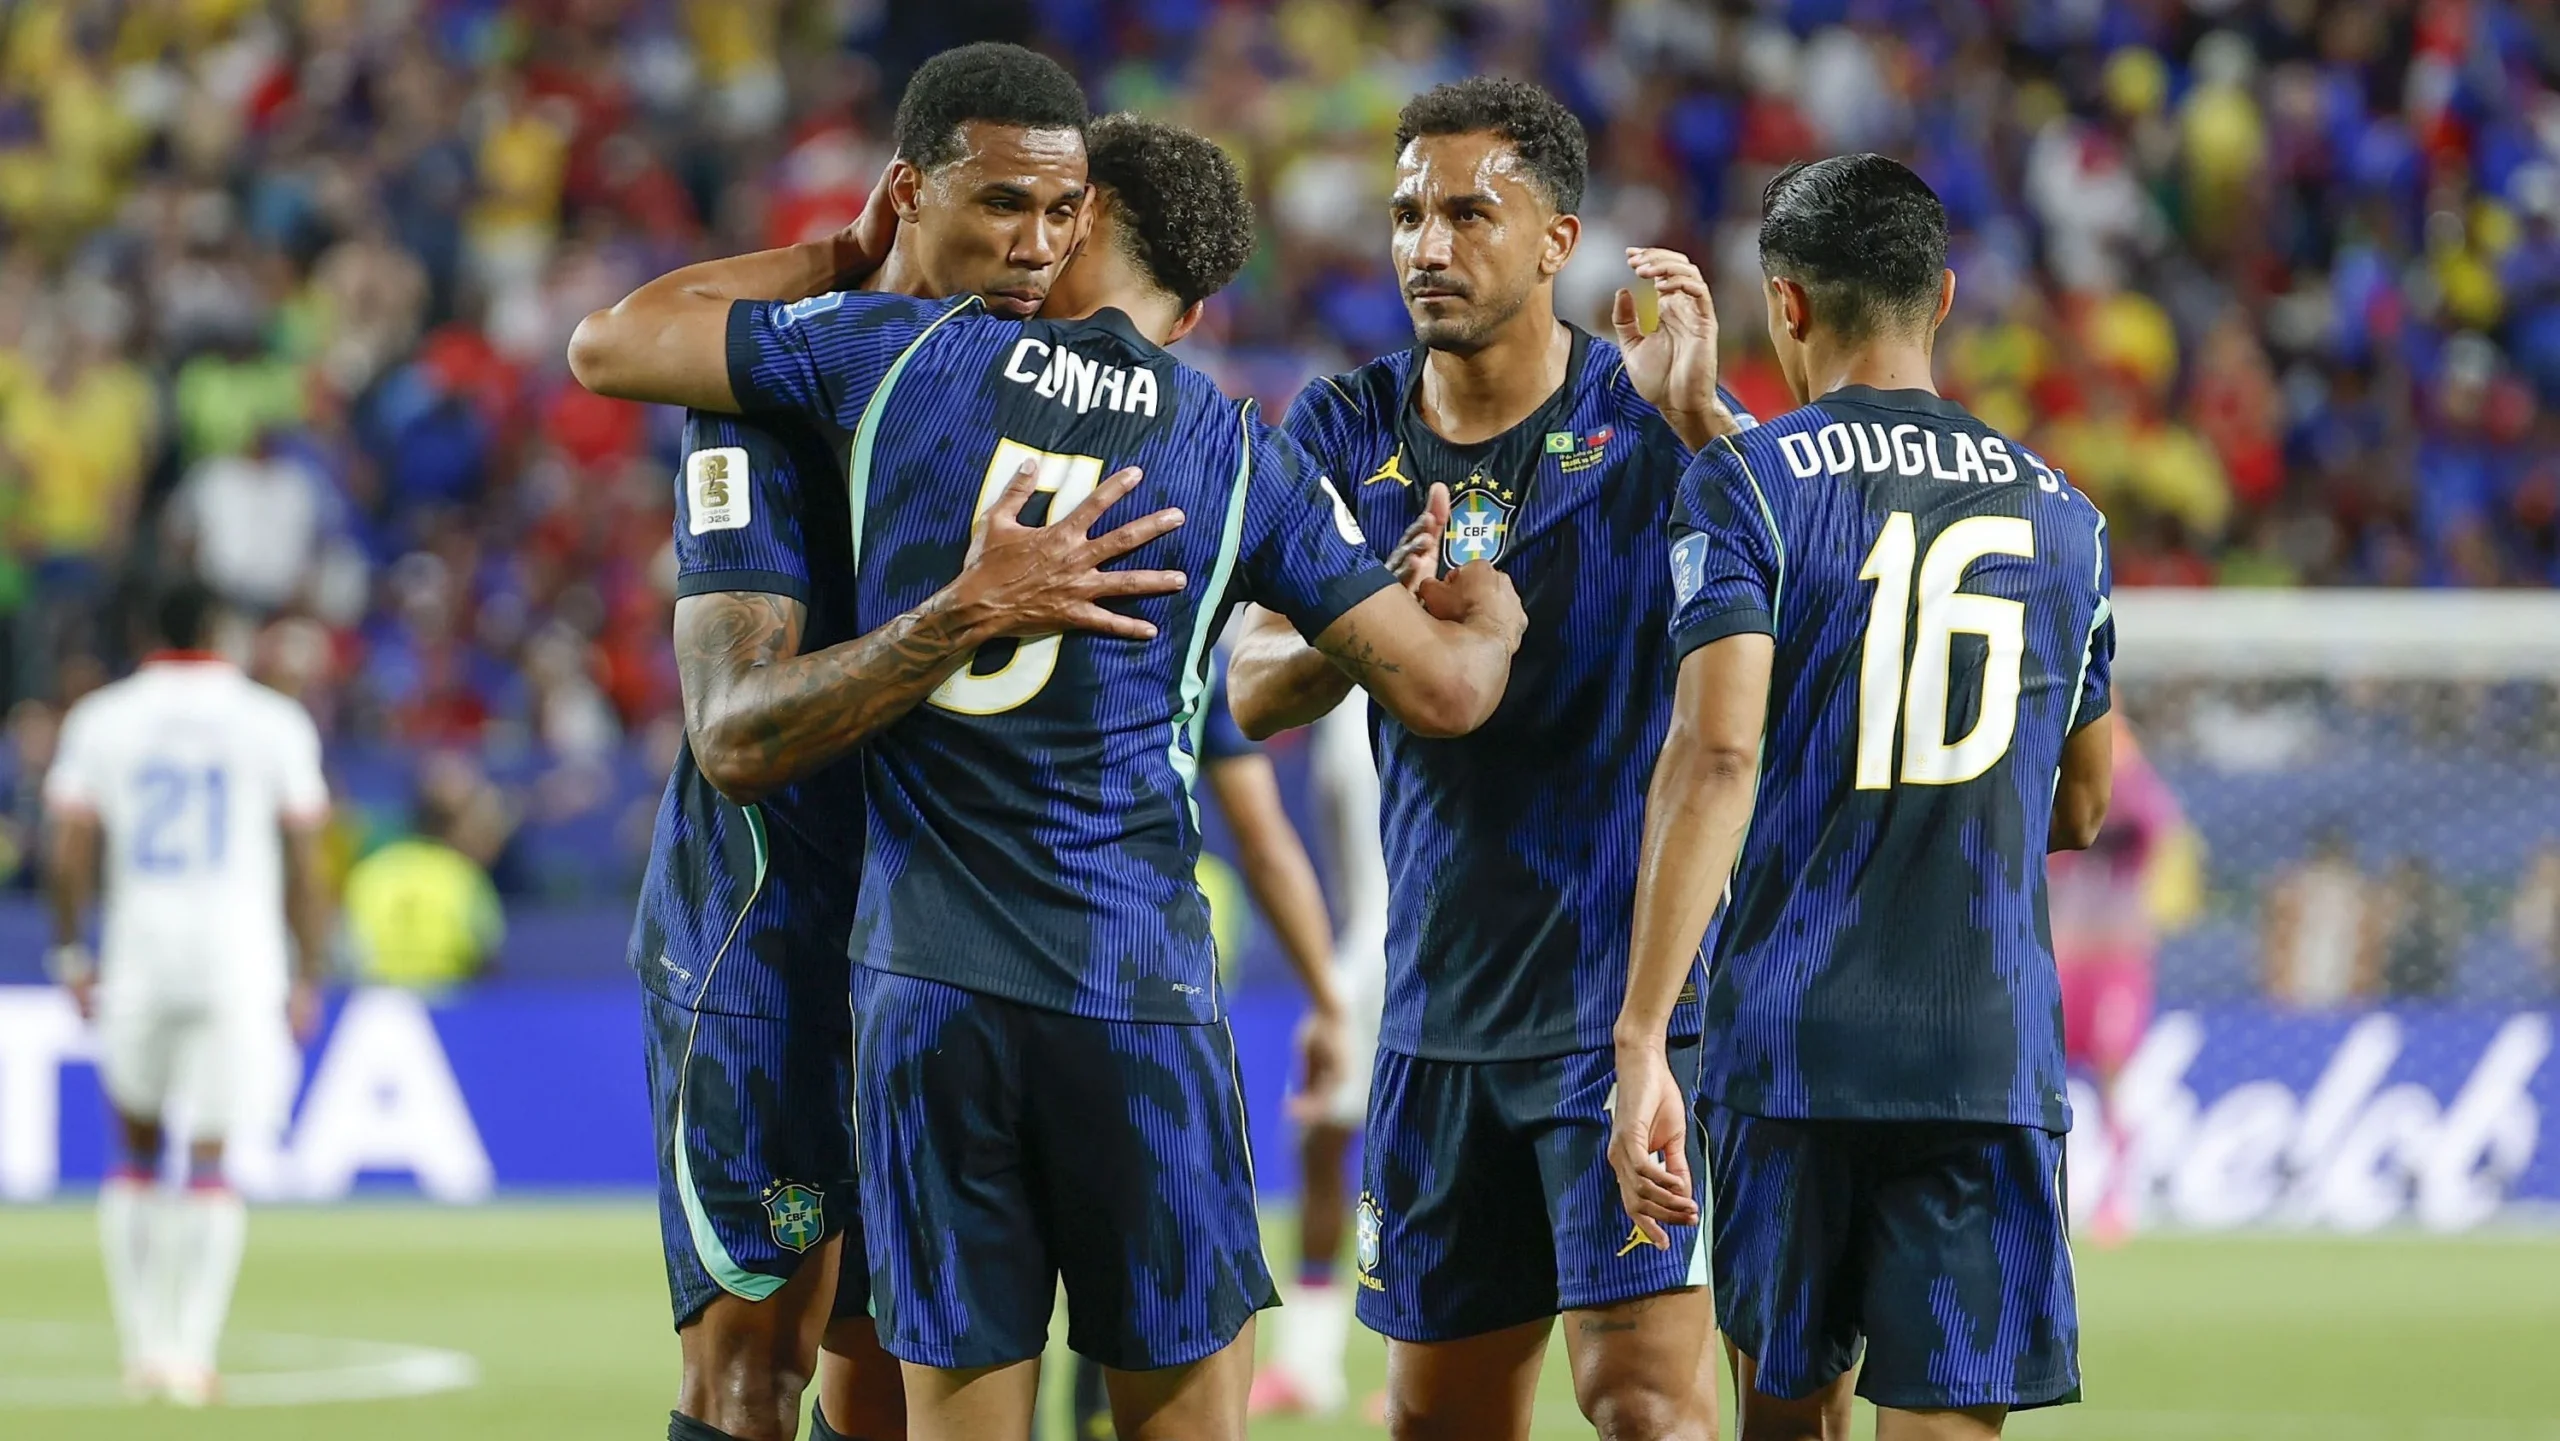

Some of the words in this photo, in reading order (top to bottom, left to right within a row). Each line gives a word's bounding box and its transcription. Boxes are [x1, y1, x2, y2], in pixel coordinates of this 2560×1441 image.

[1003, 338, 1159, 418] CUNHA
[1777, 422, 2018, 484] DOUGLAS
[2023, 452, 2070, 501] S.
[702, 514, 730, 526] 026
[1463, 526, 1488, 537] CBF
[1855, 511, 2035, 791] 16
[132, 758, 230, 873] 21
[785, 1211, 807, 1222] CBF
